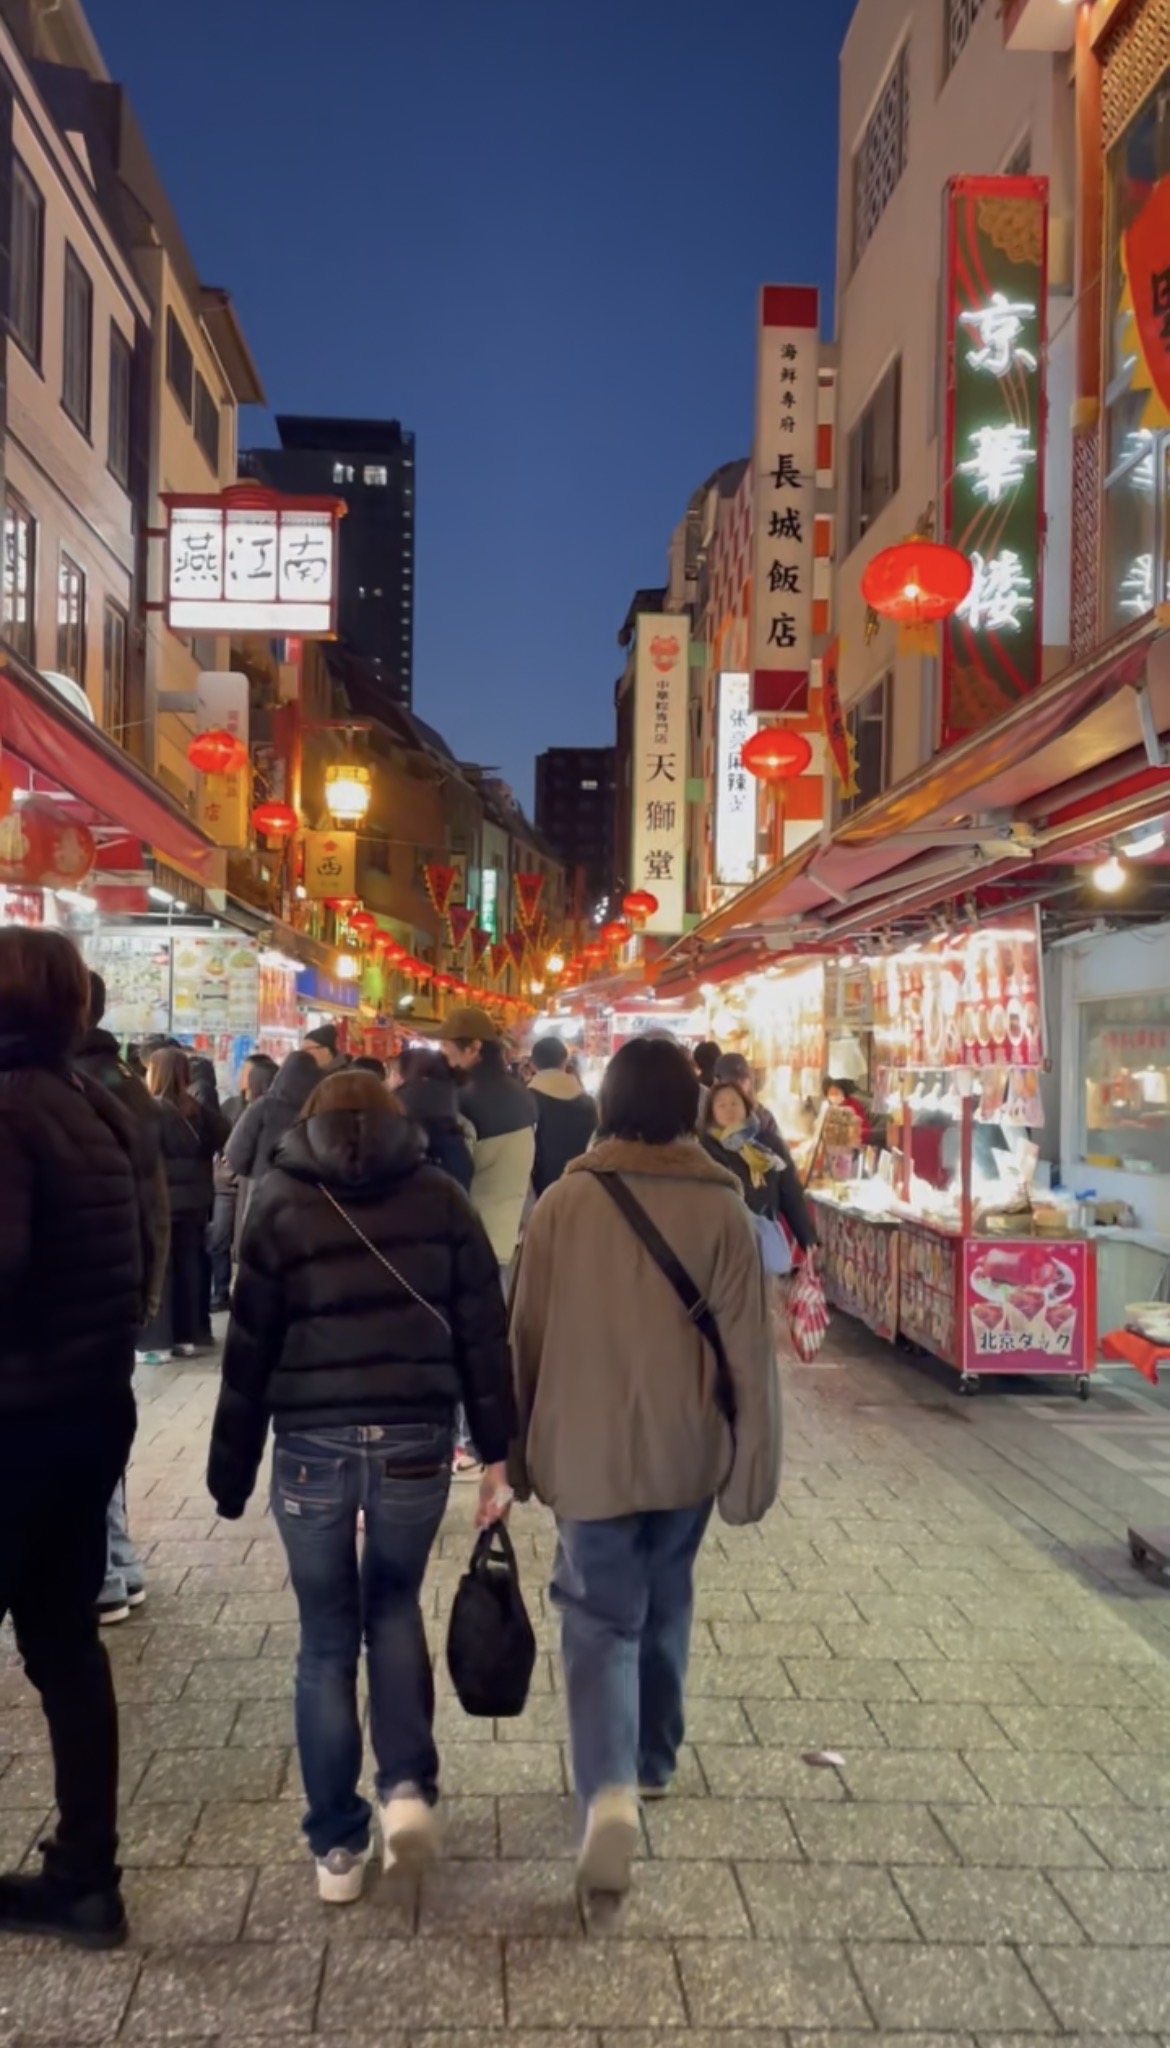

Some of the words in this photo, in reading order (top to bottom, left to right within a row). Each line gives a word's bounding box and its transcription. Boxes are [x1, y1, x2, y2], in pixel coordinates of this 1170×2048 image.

[767, 454, 803, 649] 長城飯店
[644, 753, 676, 881] 天獅堂
[980, 1331, 1070, 1351] 北京ダック
